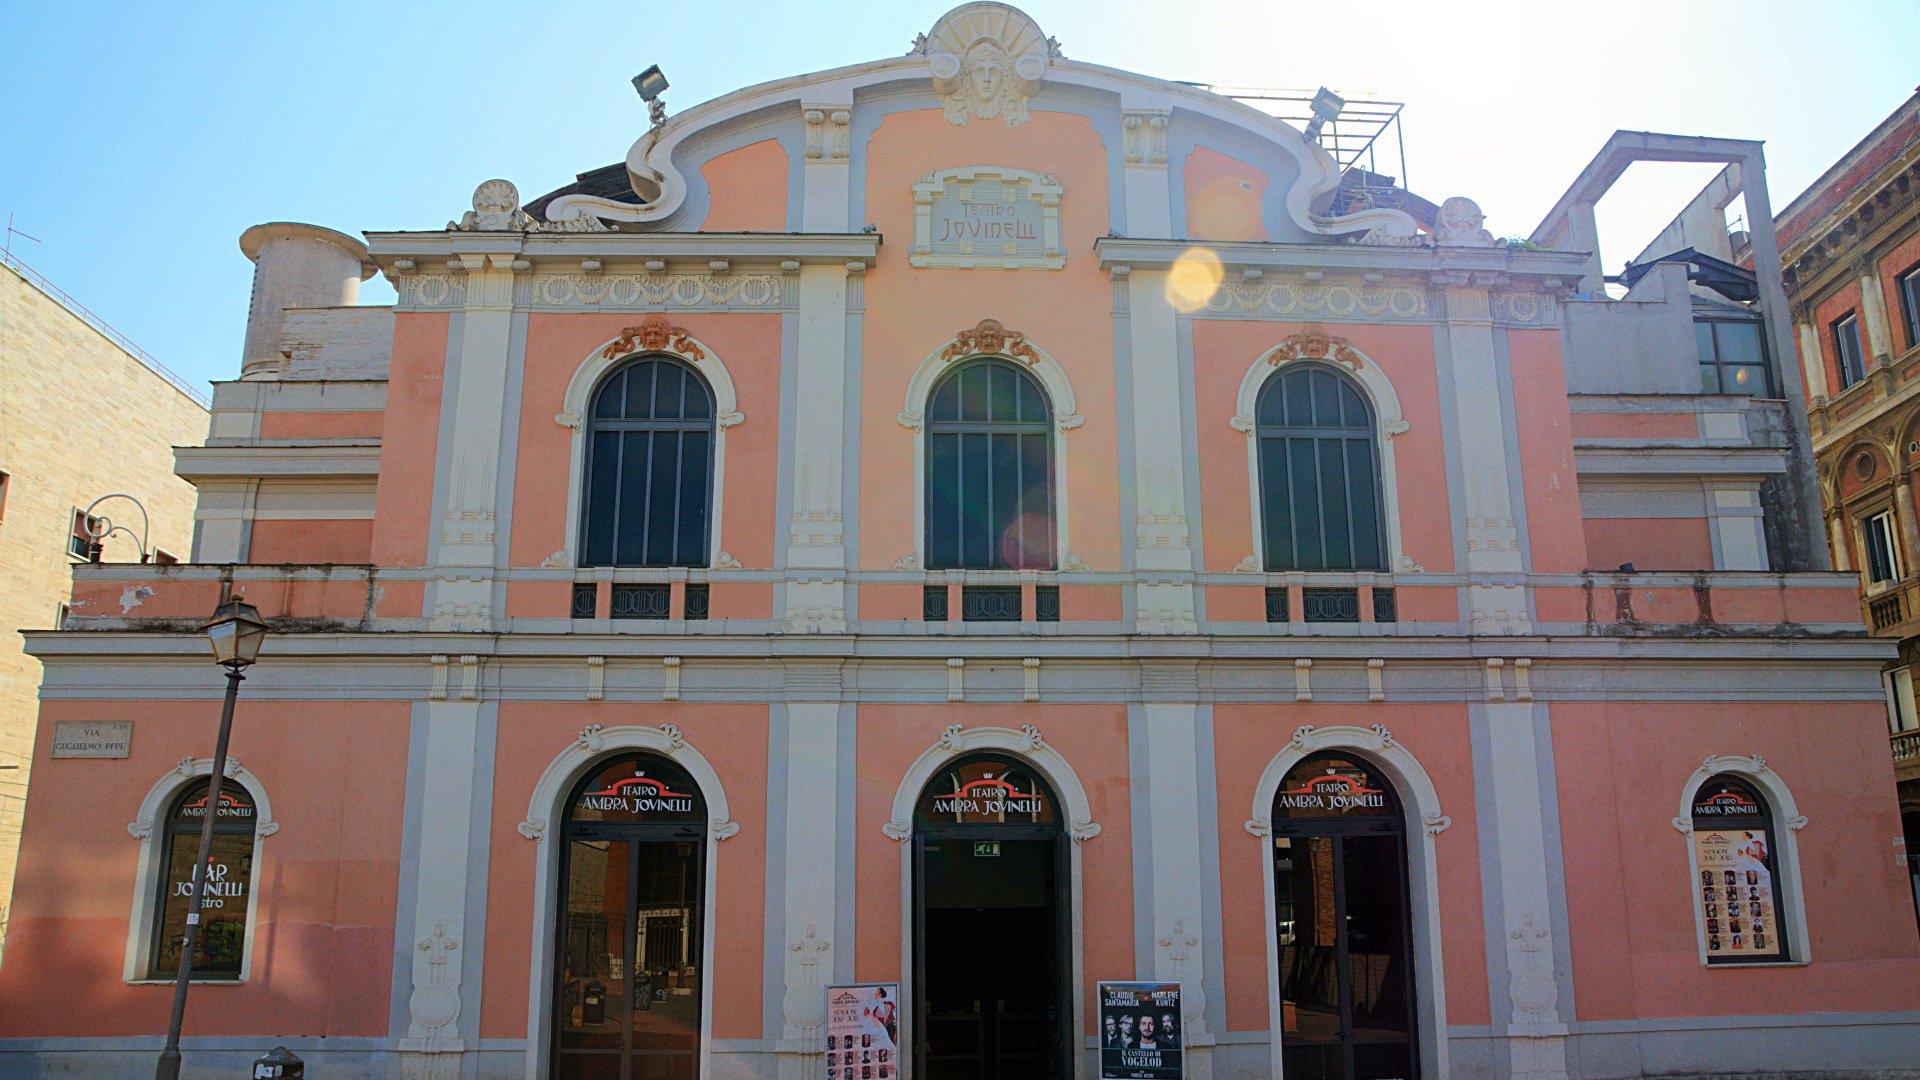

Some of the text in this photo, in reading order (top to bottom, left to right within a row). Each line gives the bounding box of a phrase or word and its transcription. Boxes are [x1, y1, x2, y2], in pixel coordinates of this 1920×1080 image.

[962, 203, 1016, 217] TEATRO
[939, 218, 1037, 242] JOVINELLI
[84, 729, 100, 737] VIA
[55, 742, 124, 750] GUGLIELMO PEPE
[622, 785, 657, 796] TEATRO
[971, 788, 1007, 798] TEATRO
[1315, 783, 1350, 793] TEATRO
[583, 796, 692, 814] AMBRA JOVINELLI
[933, 799, 1041, 816] AMBRA JOVINELLI
[1279, 795, 1384, 811] AMBRA JOVINELLI
[181, 807, 252, 817] AMBR OVINELLI
[1695, 805, 1758, 816] AMBRA JOVINELLI
[172, 882, 243, 897] JOINELLI
[200, 897, 224, 908] stro
[1109, 991, 1134, 999] CLAUDIO
[1151, 991, 1179, 999] MARLENE
[1104, 999, 1140, 1007] SANTAMARIA
[1155, 999, 1175, 1007] KUNTZ
[1121, 1056, 1162, 1067] VOGELOD
